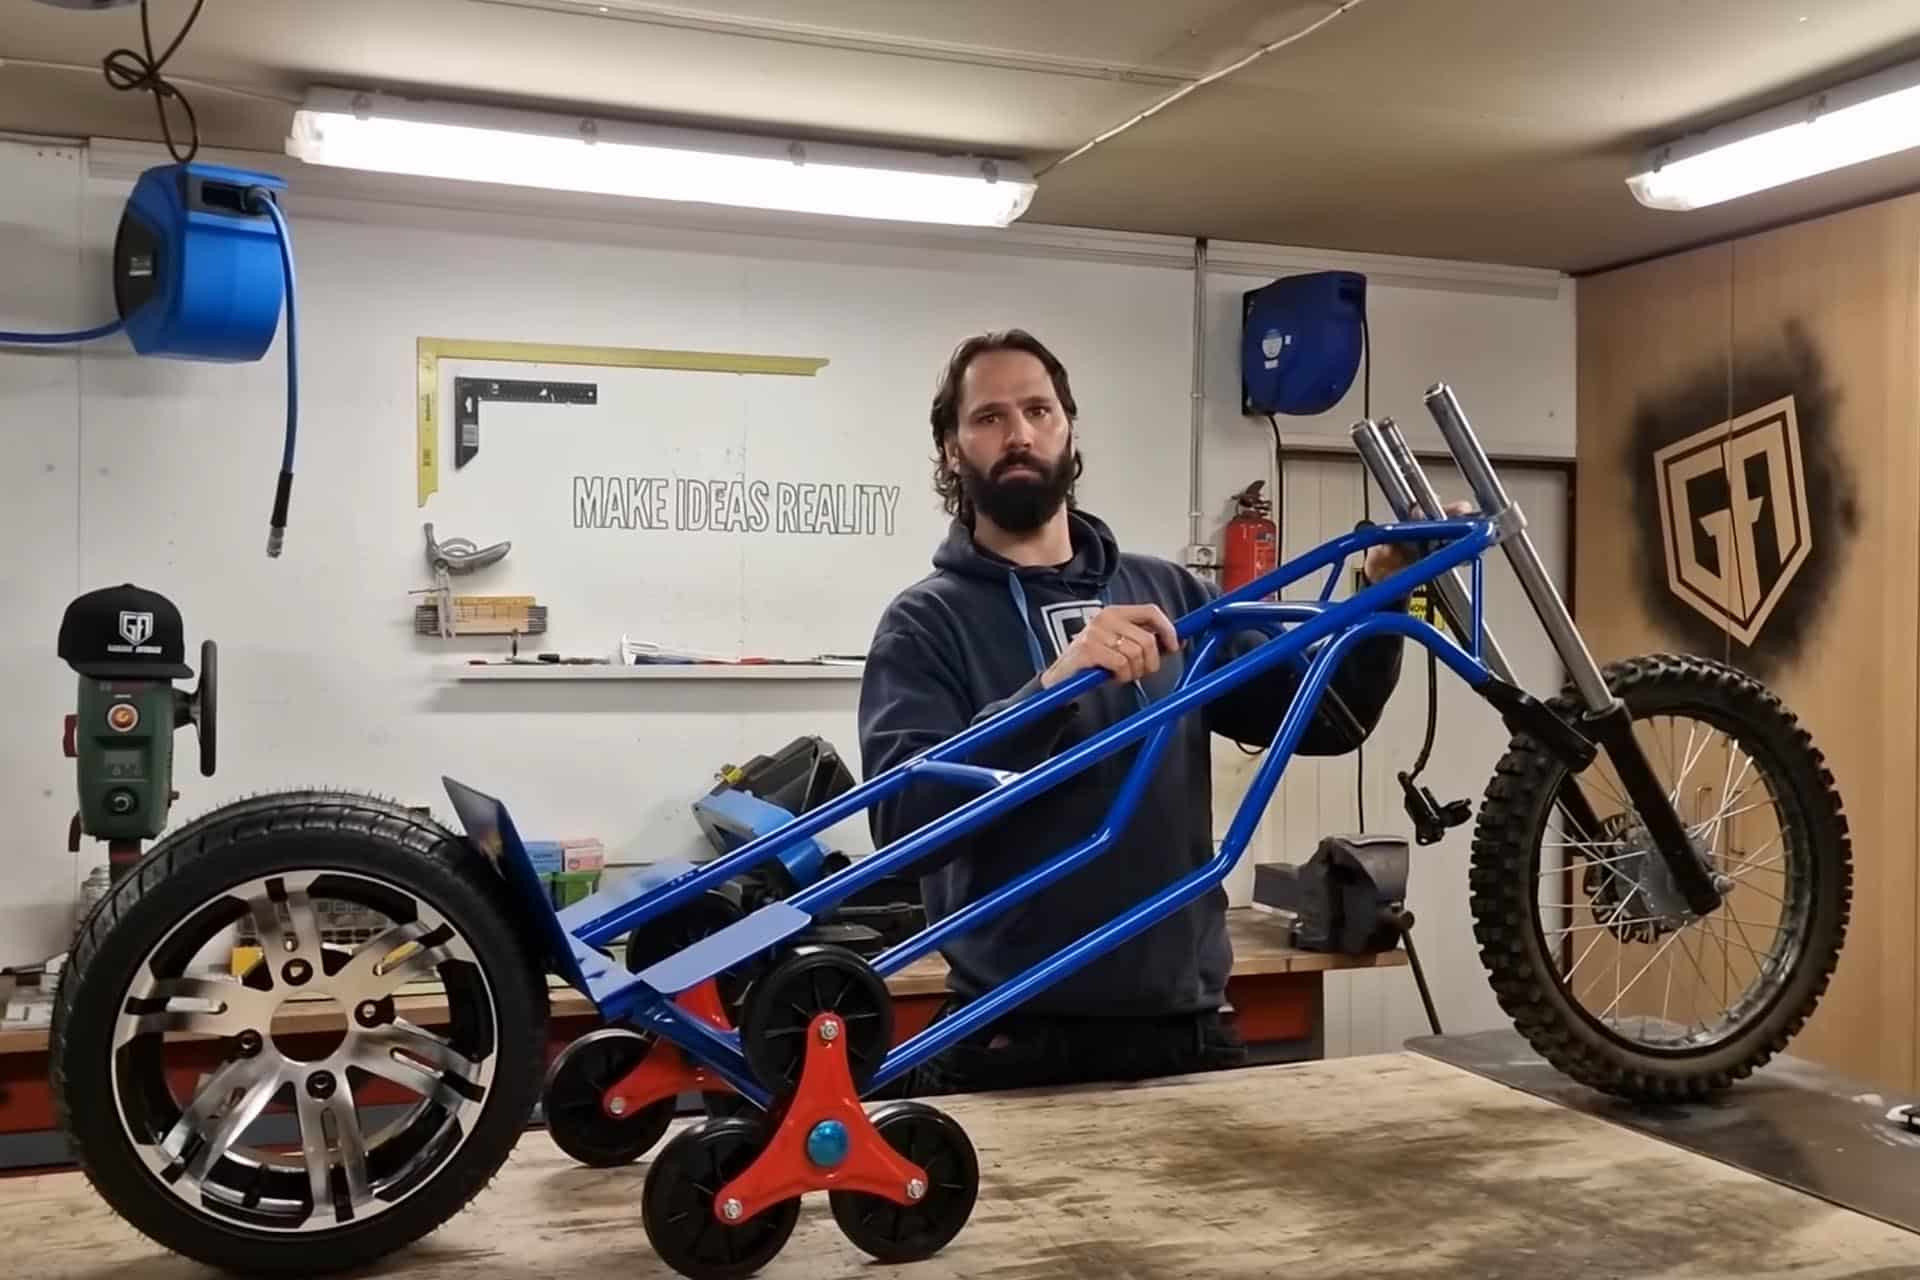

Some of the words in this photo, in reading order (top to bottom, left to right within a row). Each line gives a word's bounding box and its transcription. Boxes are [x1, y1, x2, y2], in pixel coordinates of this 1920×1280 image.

[573, 476, 669, 529] MAKE
[676, 479, 769, 532] IDEAS
[776, 482, 900, 536] REALITY
